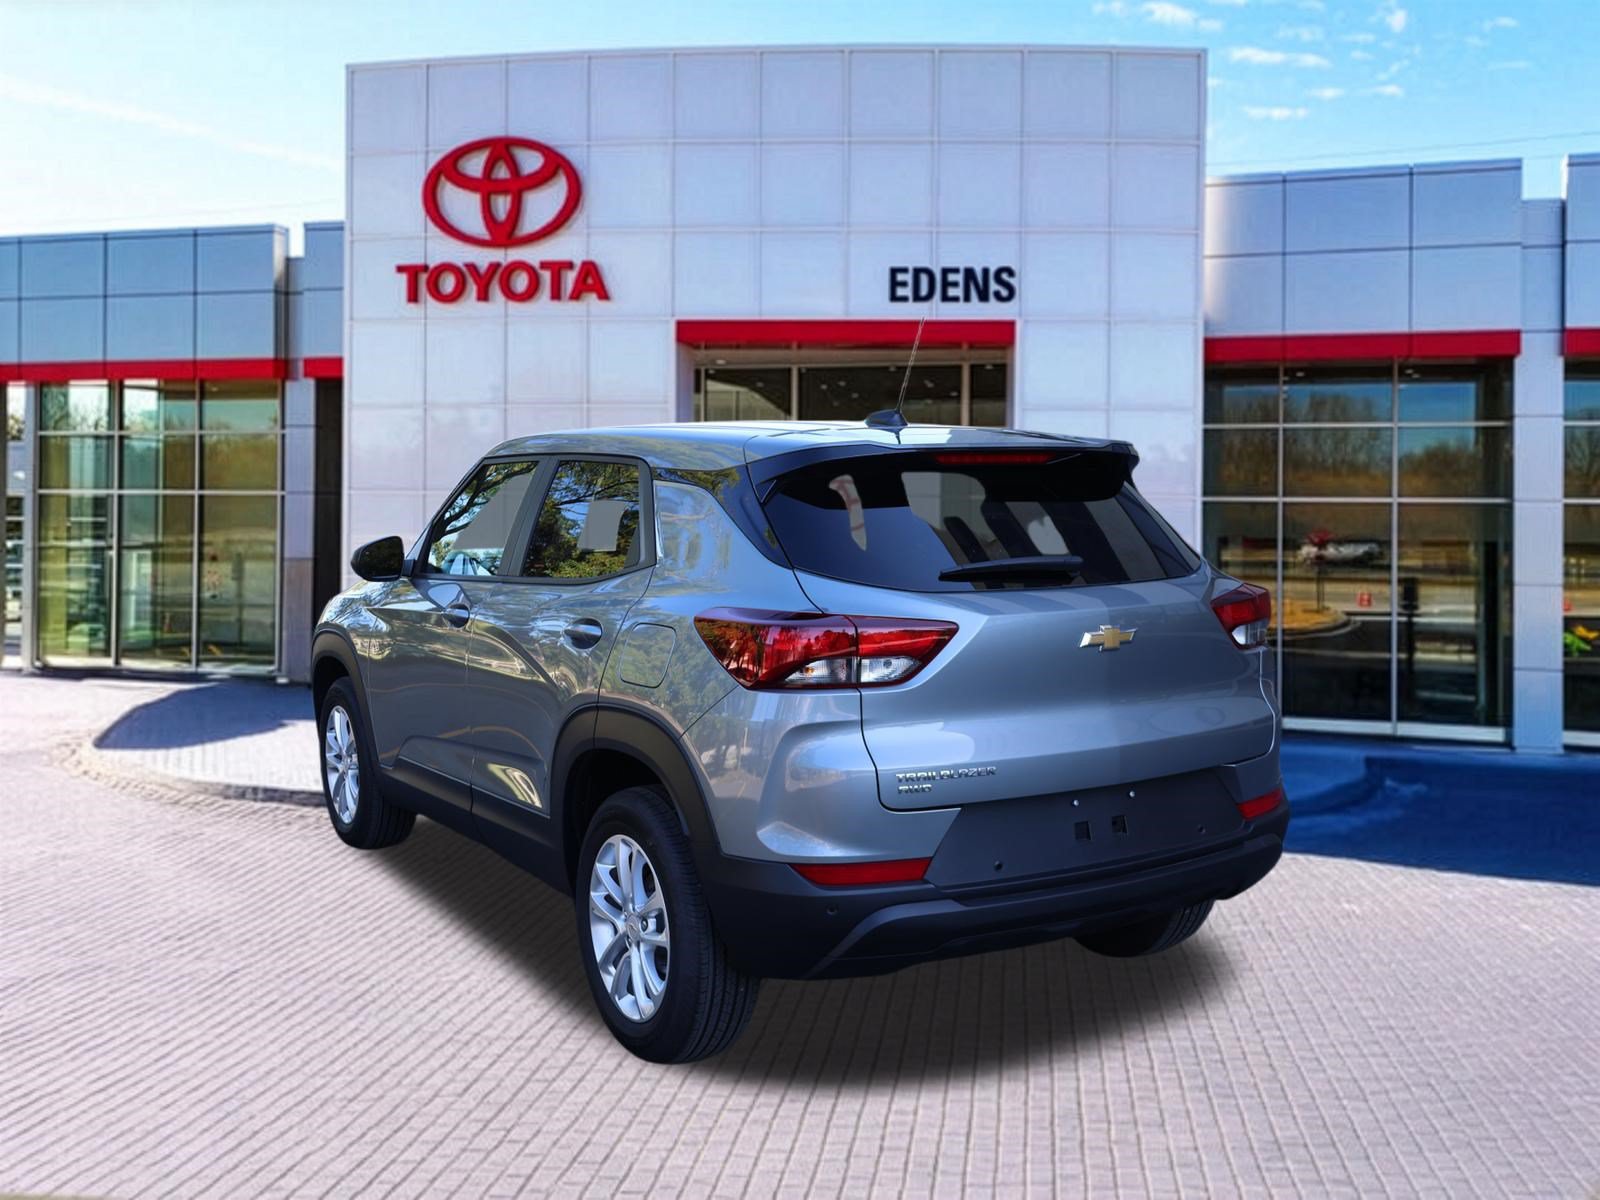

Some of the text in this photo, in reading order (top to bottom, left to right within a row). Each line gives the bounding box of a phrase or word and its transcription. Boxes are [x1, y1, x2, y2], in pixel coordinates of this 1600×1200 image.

[396, 259, 610, 304] TOYOTA
[889, 266, 1016, 303] EDENS
[896, 766, 996, 783] TRAILBLAZER
